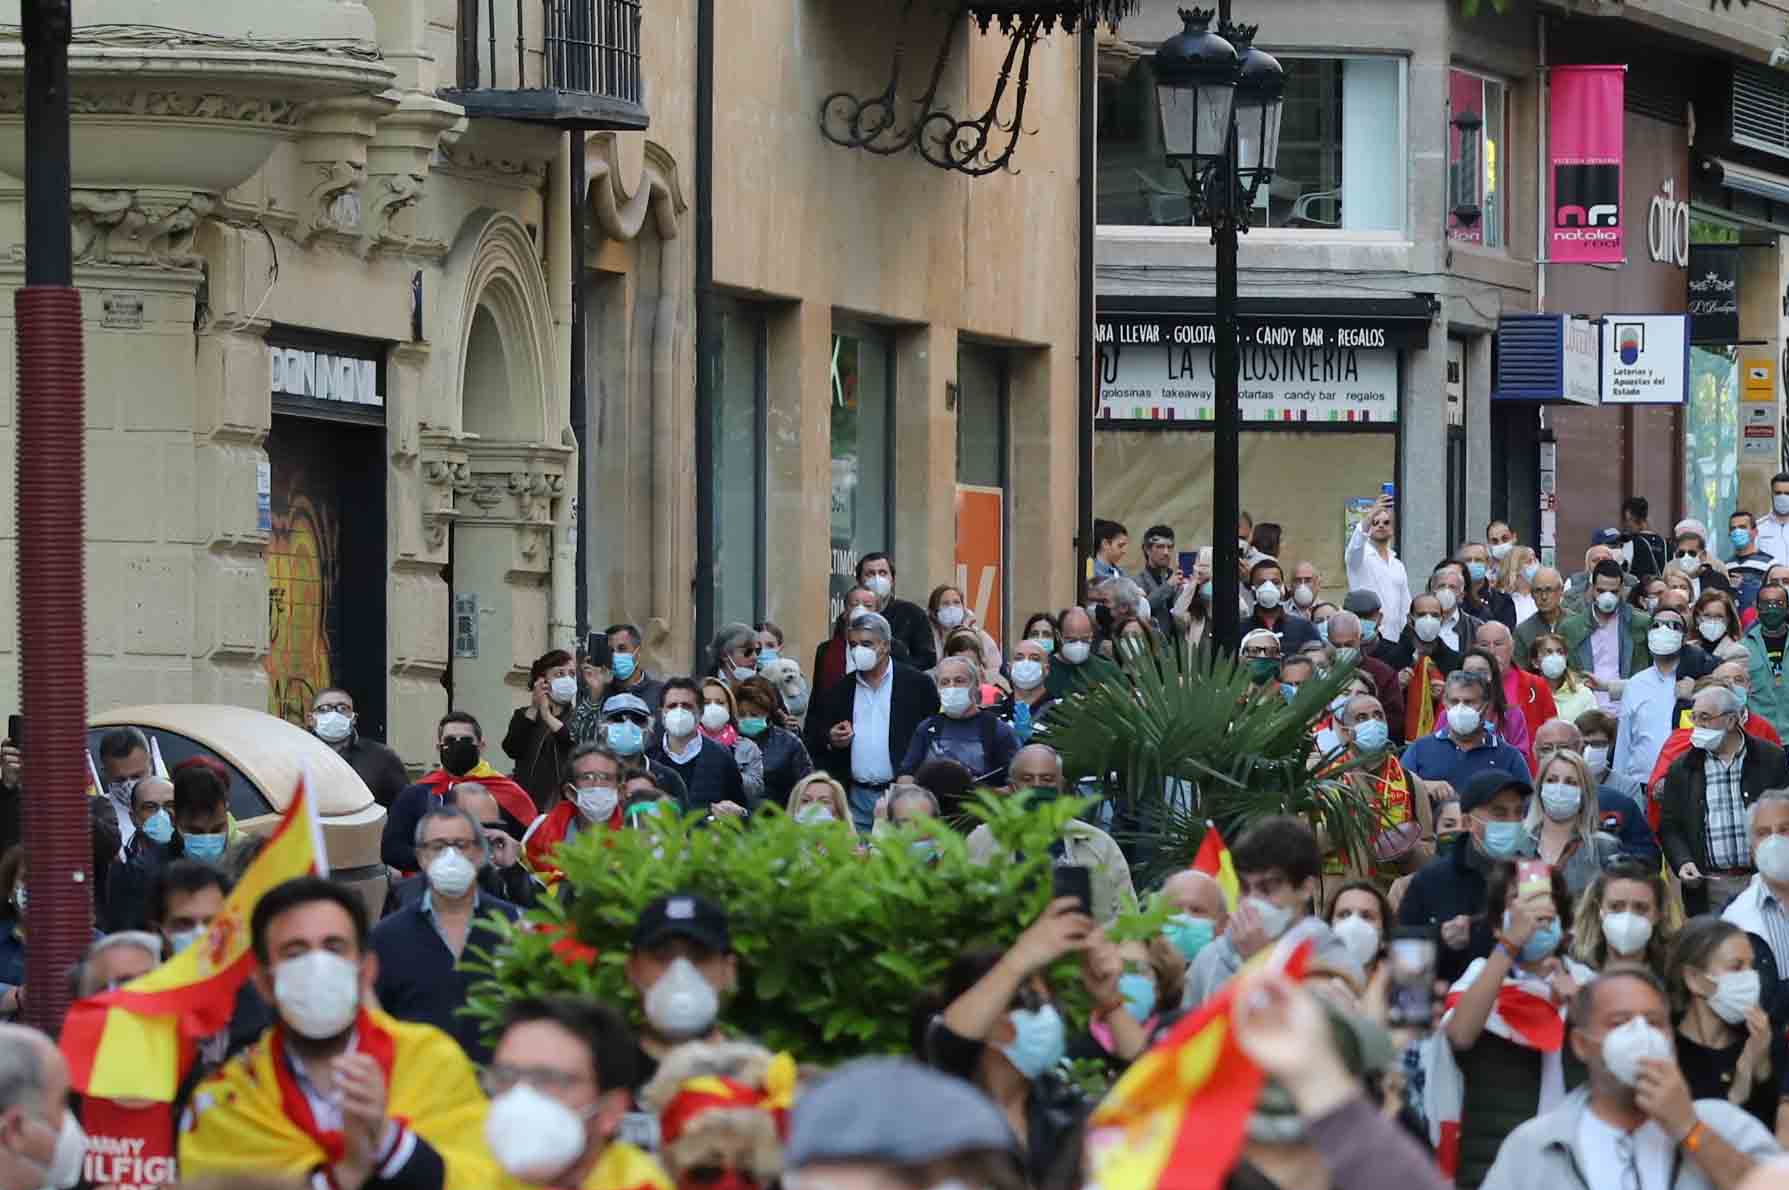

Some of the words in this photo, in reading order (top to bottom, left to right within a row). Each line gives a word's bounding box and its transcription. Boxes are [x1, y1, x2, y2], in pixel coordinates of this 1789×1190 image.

[1553, 229, 1617, 241] natalia
[1095, 325, 1114, 343] ARA
[1119, 324, 1160, 343] LLEVAR
[1256, 326, 1296, 347] CANDY
[1302, 327, 1324, 346] BAR
[1337, 328, 1385, 347] REGALOS
[1168, 346, 1194, 381] LA
[1102, 388, 1151, 400] golosinas
[1162, 388, 1212, 400] takeaway
[1284, 391, 1315, 402] candy
[1319, 391, 1336, 400] bar
[1346, 392, 1385, 402] regalos
